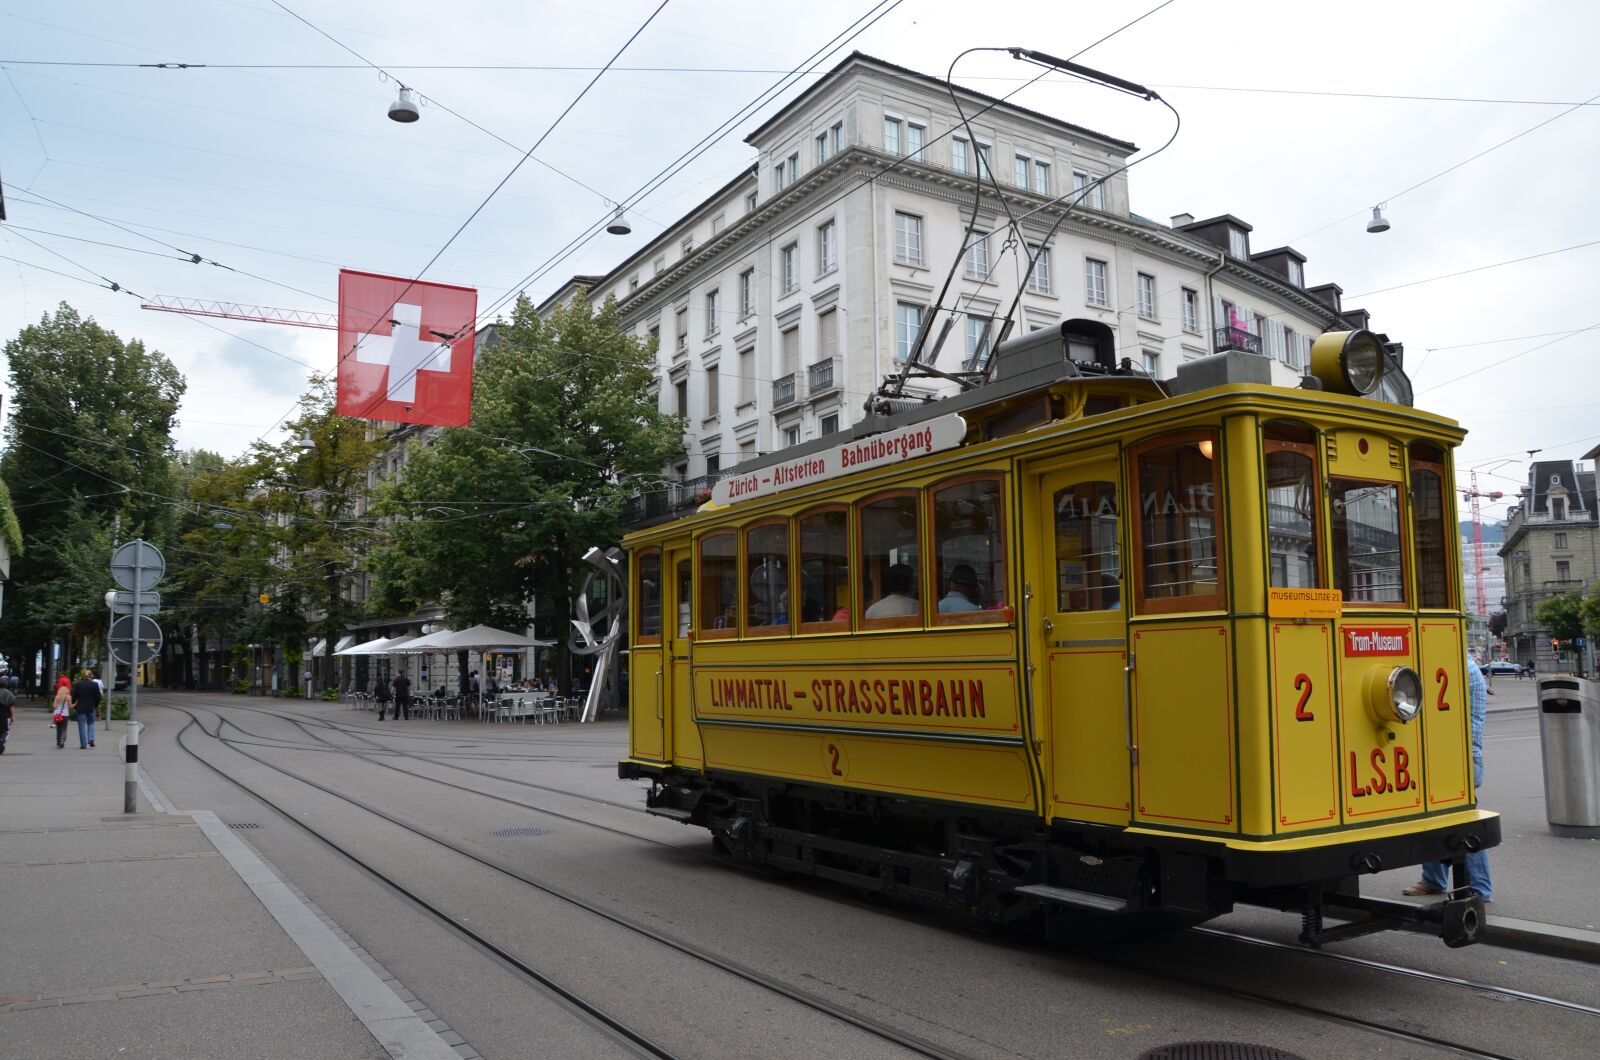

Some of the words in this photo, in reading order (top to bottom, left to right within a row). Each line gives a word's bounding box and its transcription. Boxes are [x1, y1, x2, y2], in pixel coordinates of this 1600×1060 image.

[729, 475, 758, 498] Zürich
[773, 459, 825, 486] Altstetten
[841, 426, 932, 468] Bahnübergang
[1271, 591, 1330, 601] MUSEUMSLINIE
[1331, 593, 1339, 601] 21
[1350, 632, 1403, 651] Tram-Museum
[1294, 673, 1314, 721] 2
[1436, 668, 1450, 711] 2
[828, 744, 842, 776] 2
[1350, 747, 1416, 797] L.S.B.
